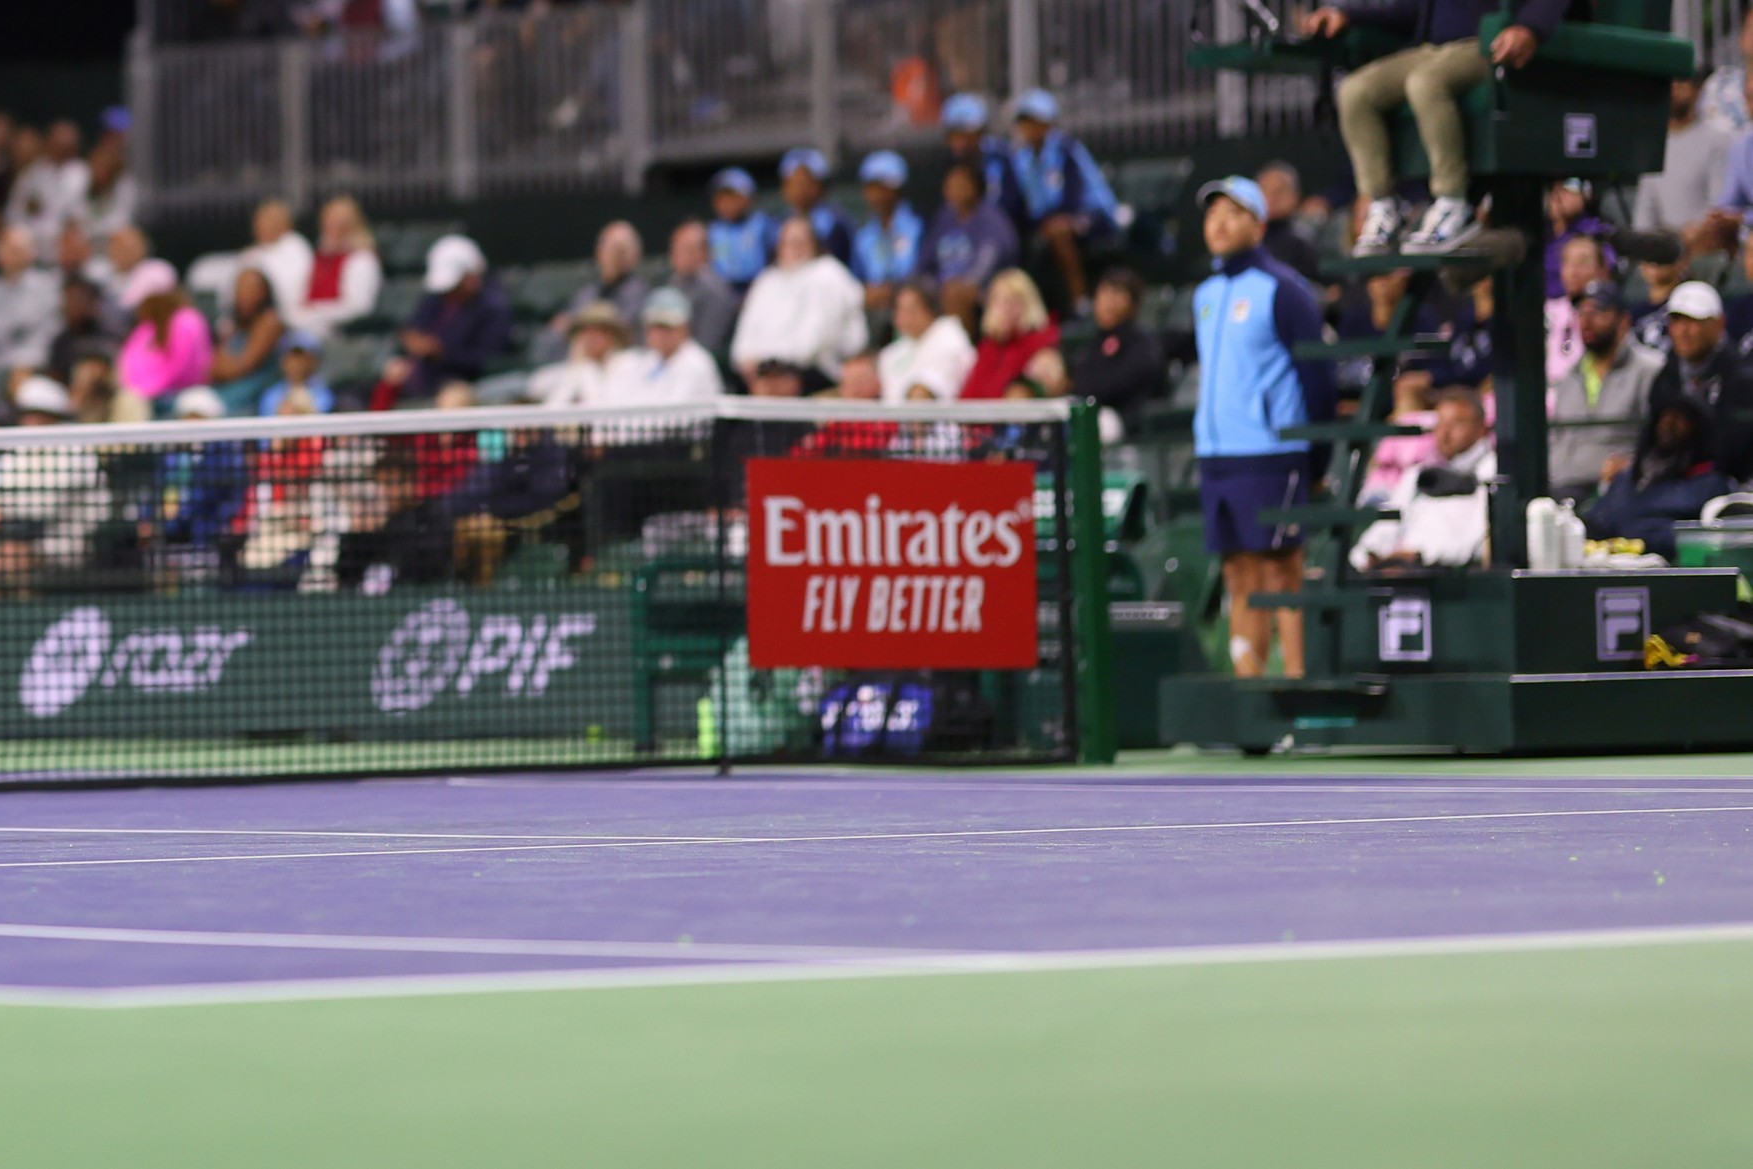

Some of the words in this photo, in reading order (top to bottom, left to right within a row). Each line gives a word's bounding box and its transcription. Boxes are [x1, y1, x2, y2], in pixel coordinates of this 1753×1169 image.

[763, 495, 1022, 567] Emirates
[802, 575, 860, 632] FLY
[866, 575, 984, 632] BETTER
[455, 614, 596, 696] PIF
